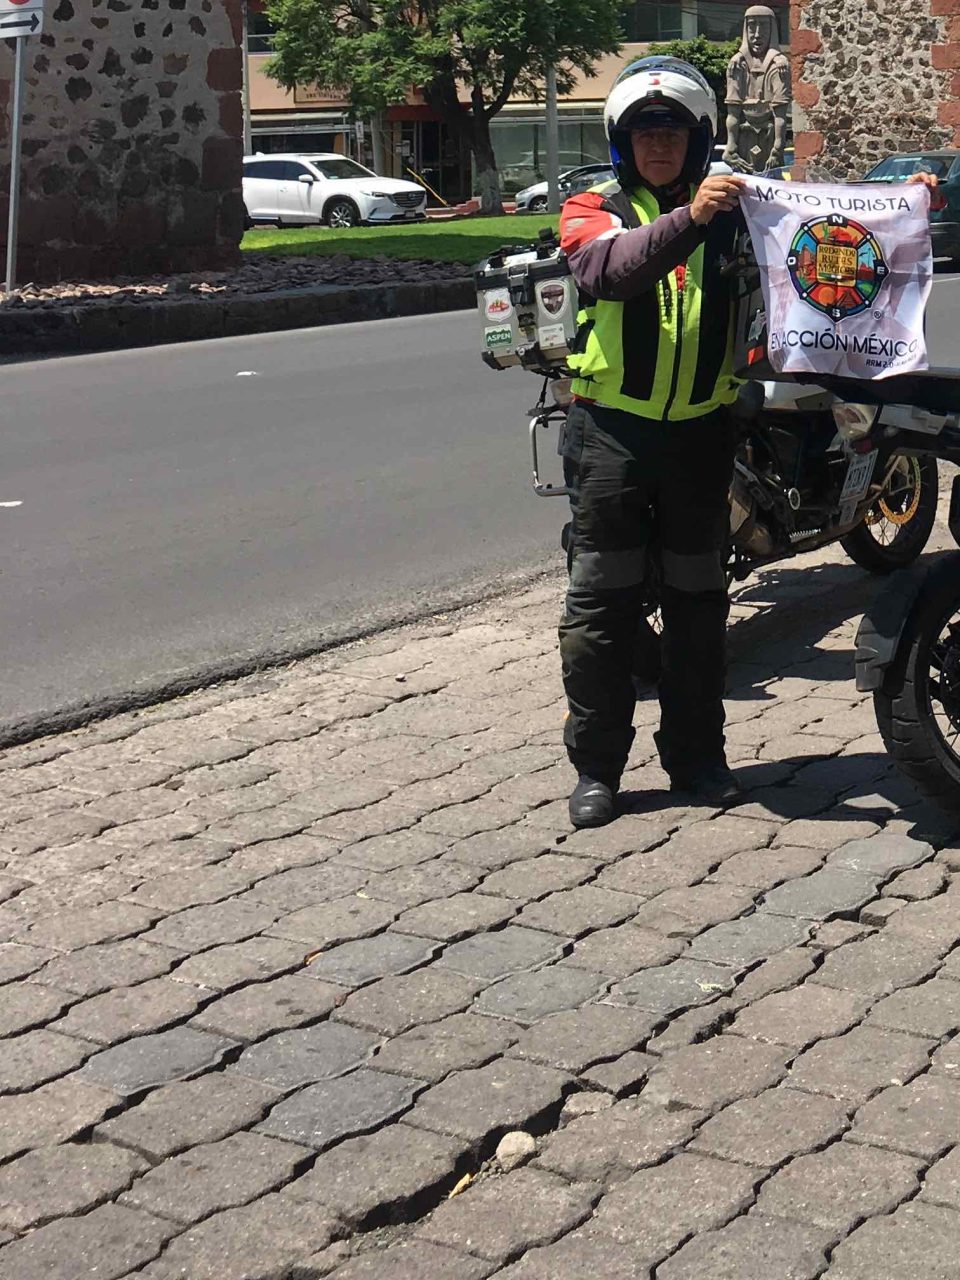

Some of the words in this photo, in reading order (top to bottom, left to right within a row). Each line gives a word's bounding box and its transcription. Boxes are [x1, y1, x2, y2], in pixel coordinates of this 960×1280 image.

[755, 184, 821, 206] MOTO
[826, 196, 911, 212] TURISTA
[832, 215, 843, 224] N
[787, 256, 796, 265] O
[876, 266, 885, 275] E
[832, 308, 841, 317] S
[487, 333, 511, 342] ASPEN
[782, 328, 848, 352] ACCIÓN
[853, 333, 918, 357] MÉXICO
